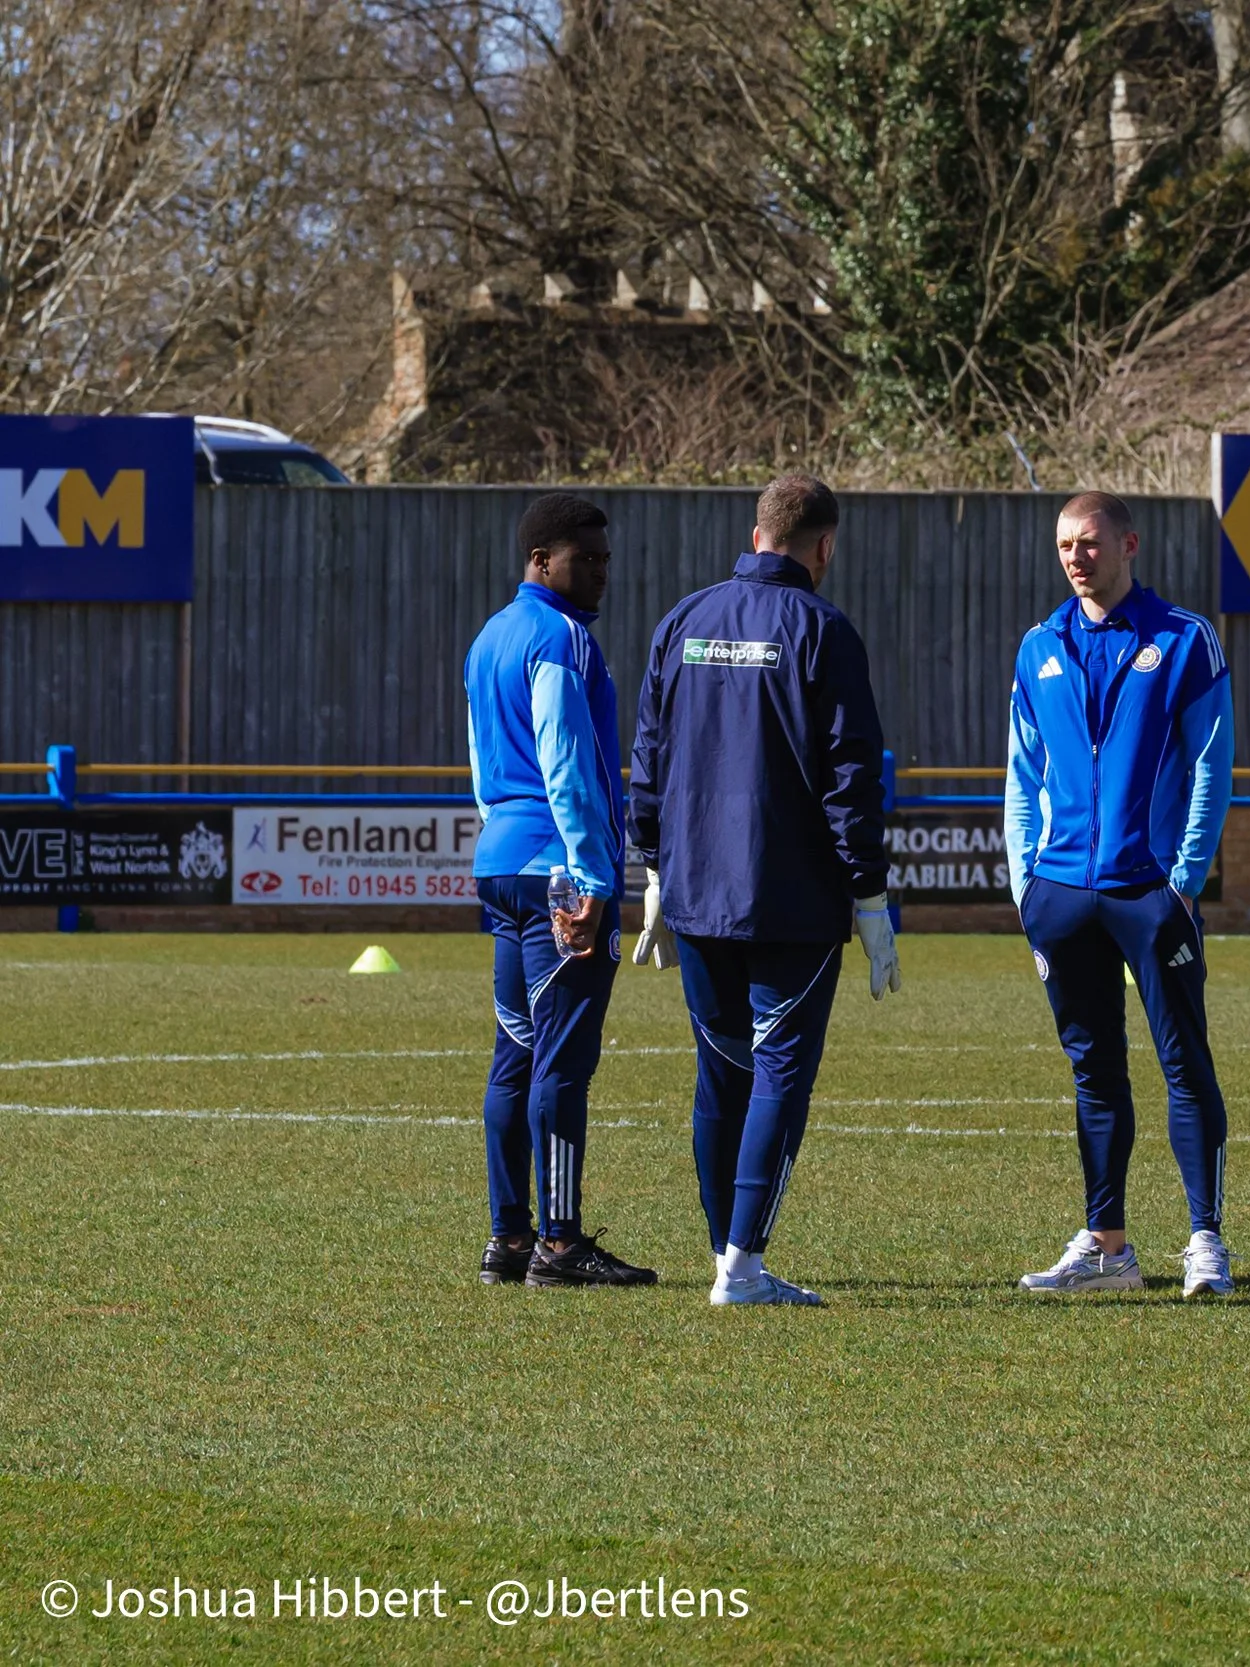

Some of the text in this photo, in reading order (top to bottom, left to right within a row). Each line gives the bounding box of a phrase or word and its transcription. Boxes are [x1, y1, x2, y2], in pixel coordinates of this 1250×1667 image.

[685, 644, 778, 662] enterprise
[277, 816, 436, 852] Fenland
[129, 844, 158, 858] Lynn
[160, 844, 169, 856] &
[89, 861, 170, 875] West Norfolk
[318, 855, 342, 867] Fire
[346, 855, 412, 867] Protection
[298, 875, 338, 897] Tel:
[348, 875, 417, 897] 01945
